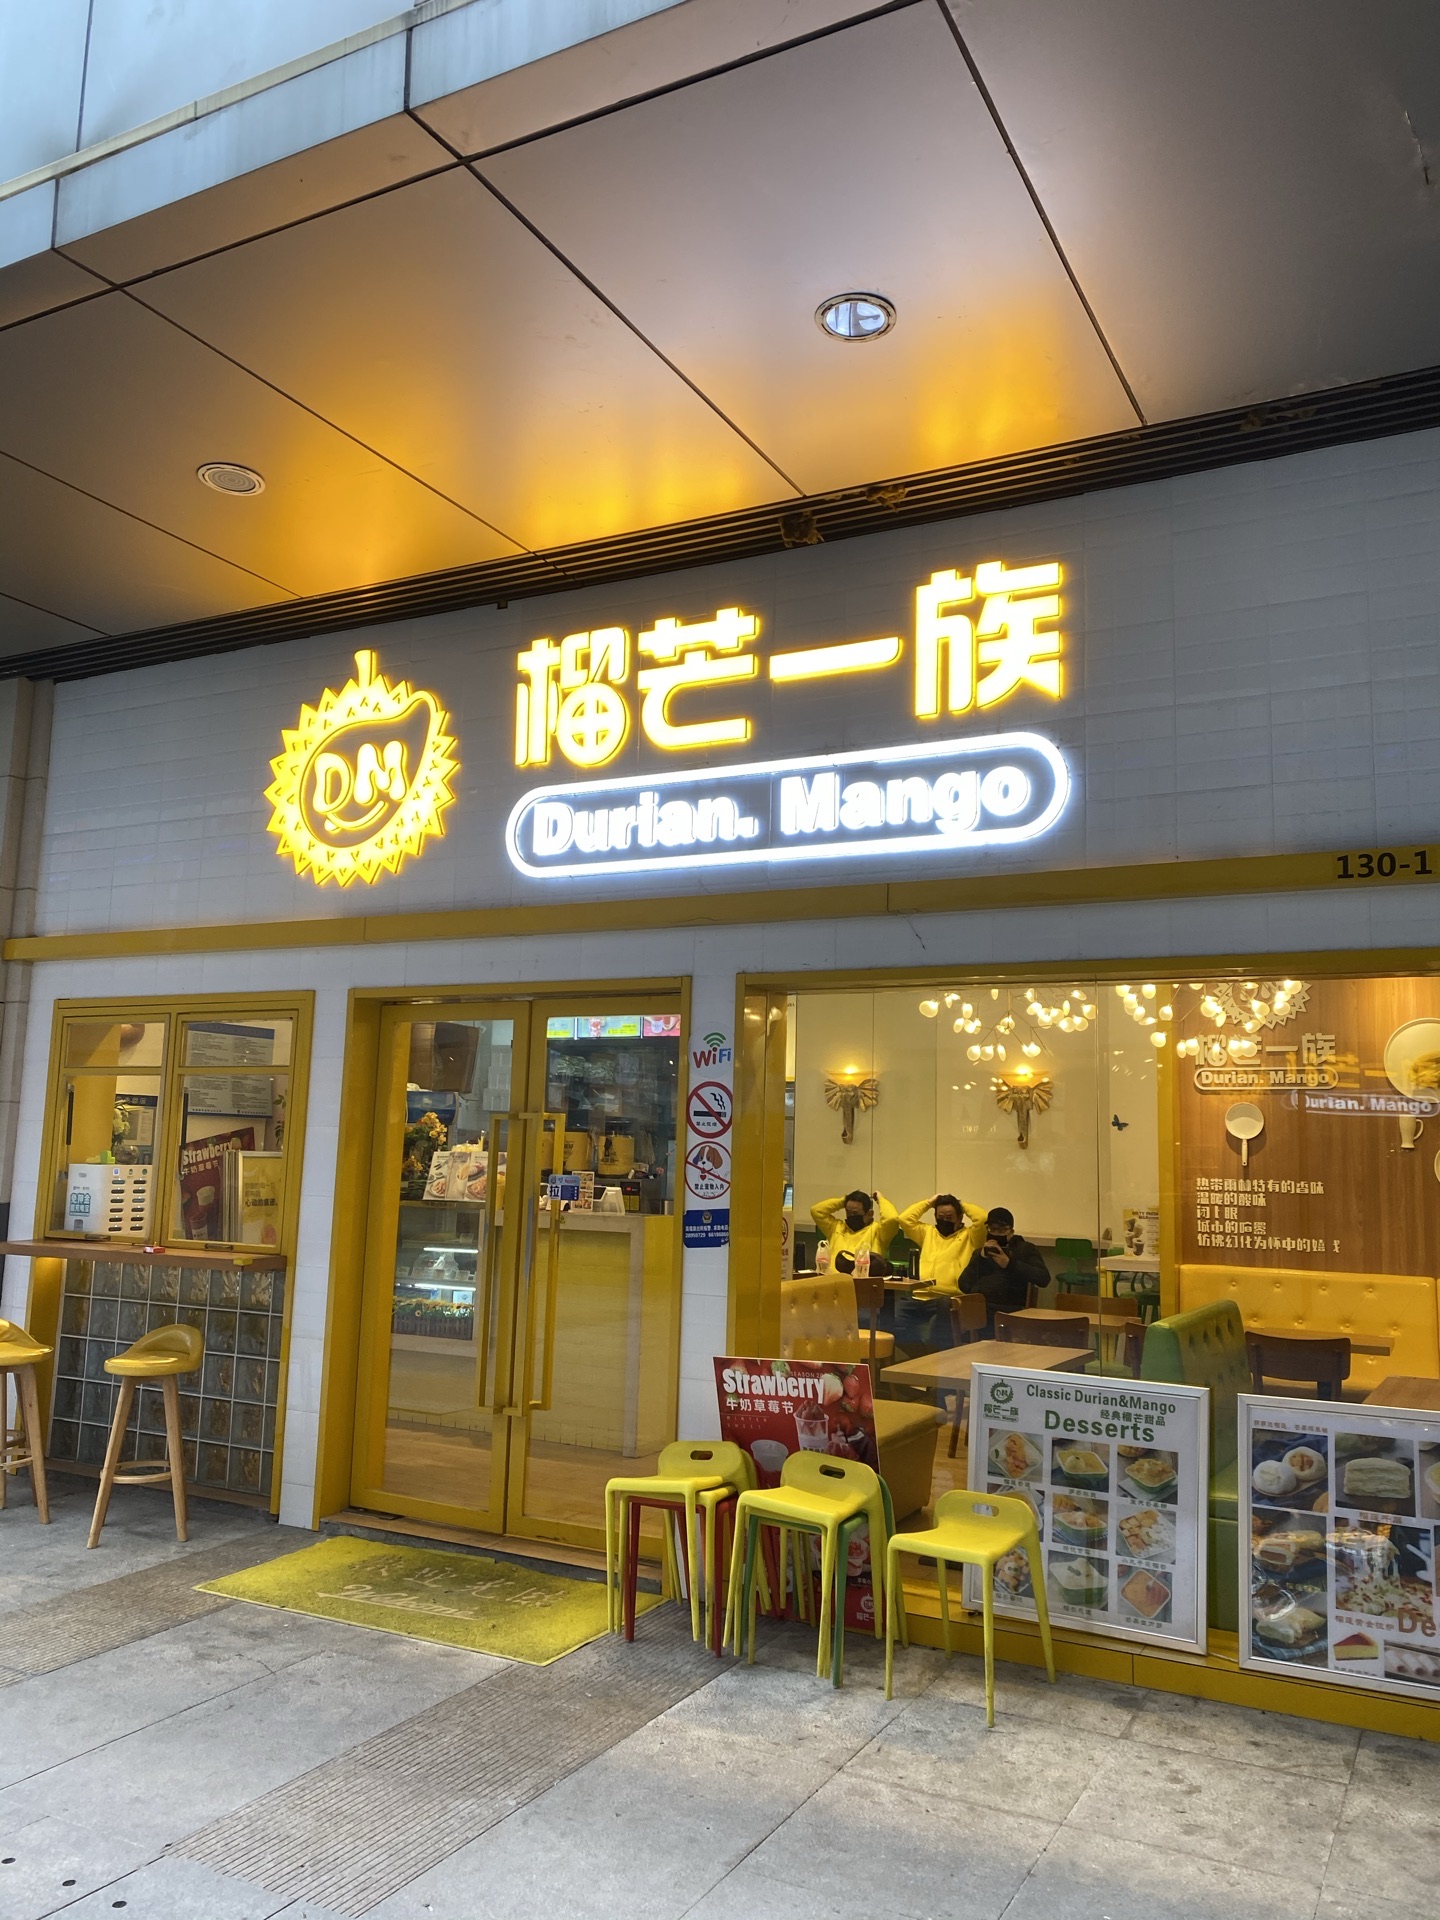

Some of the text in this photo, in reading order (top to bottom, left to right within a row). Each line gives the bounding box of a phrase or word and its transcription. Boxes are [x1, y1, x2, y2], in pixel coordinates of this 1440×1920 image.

[515, 560, 1063, 768] 榴芒一族
[313, 740, 408, 814] DM
[780, 765, 1030, 834] Mango
[1337, 850, 1433, 879] 130-1
[693, 1047, 731, 1068] WiFi
[1270, 1071, 1329, 1087] Mango
[549, 1185, 560, 1198] 拉
[722, 1369, 825, 1404] Strawberry
[1026, 1384, 1176, 1415] Classic Durian&Mango
[726, 1398, 794, 1415] 牛奶草莓节
[1100, 1409, 1166, 1426] 经典榴芒甜品
[1045, 1410, 1155, 1442] Desserts
